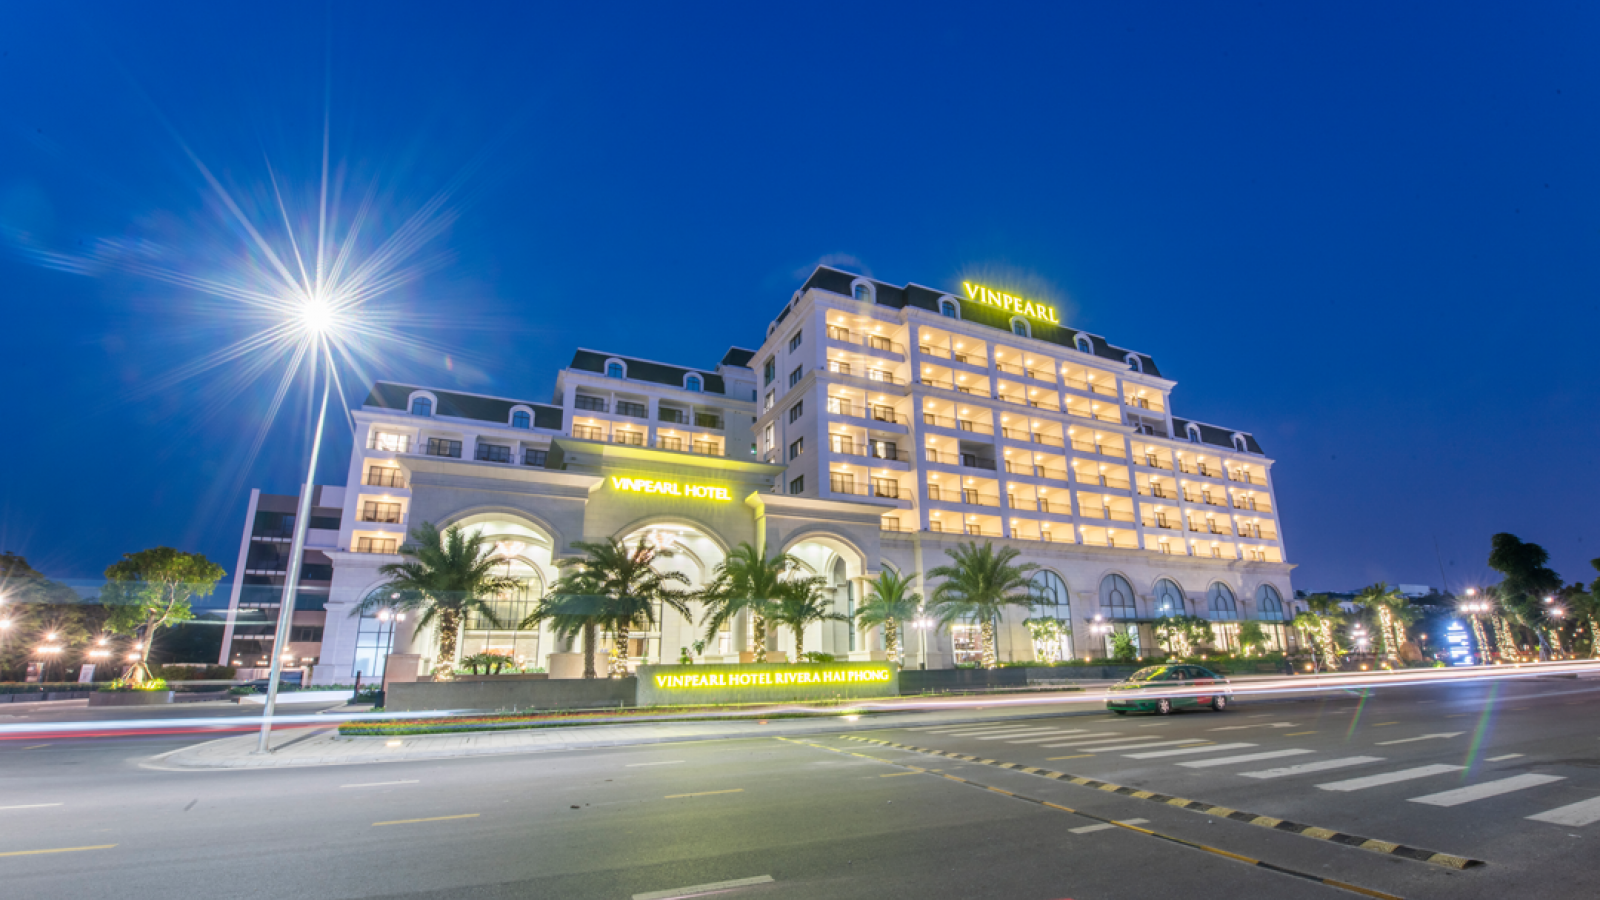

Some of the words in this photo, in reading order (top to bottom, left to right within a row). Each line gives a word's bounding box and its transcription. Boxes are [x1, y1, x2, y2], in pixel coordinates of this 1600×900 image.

[962, 281, 1059, 323] VINPEARL
[612, 476, 682, 495] VINPEARL
[685, 484, 732, 500] HOTEL
[654, 674, 727, 687] VINPEARL
[728, 672, 773, 685] HOTEL
[774, 672, 821, 684] RIVERA
[823, 671, 845, 682] HAI
[848, 669, 889, 681] PHONG
